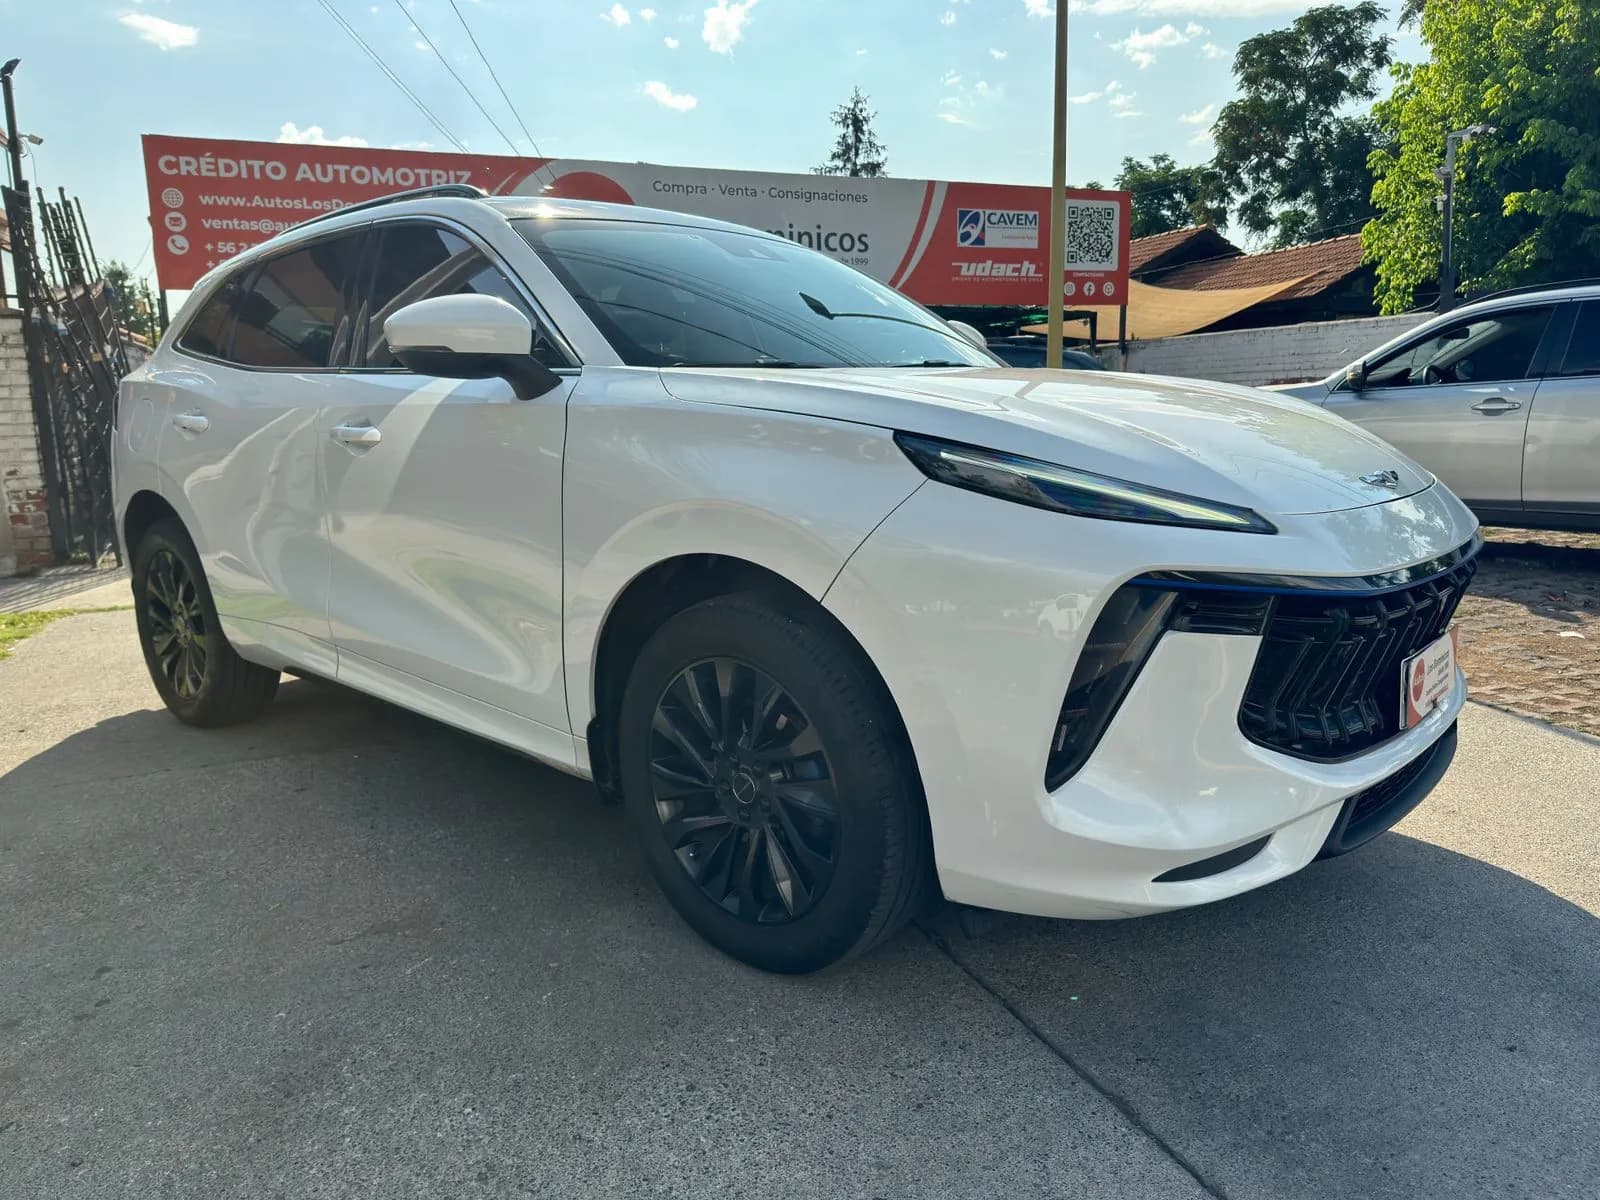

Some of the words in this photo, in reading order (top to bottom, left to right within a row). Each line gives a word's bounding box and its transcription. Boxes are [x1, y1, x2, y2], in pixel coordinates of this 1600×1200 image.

[158, 152, 287, 181] CRÉDITO
[295, 162, 472, 187] AUTOMOTRIZ
[653, 180, 707, 196] Compra
[719, 183, 758, 198] Venta
[768, 186, 869, 203] Consignaciones
[987, 212, 1038, 226] CAVEM
[217, 241, 236, 253] 56
[952, 260, 1043, 277] udach
